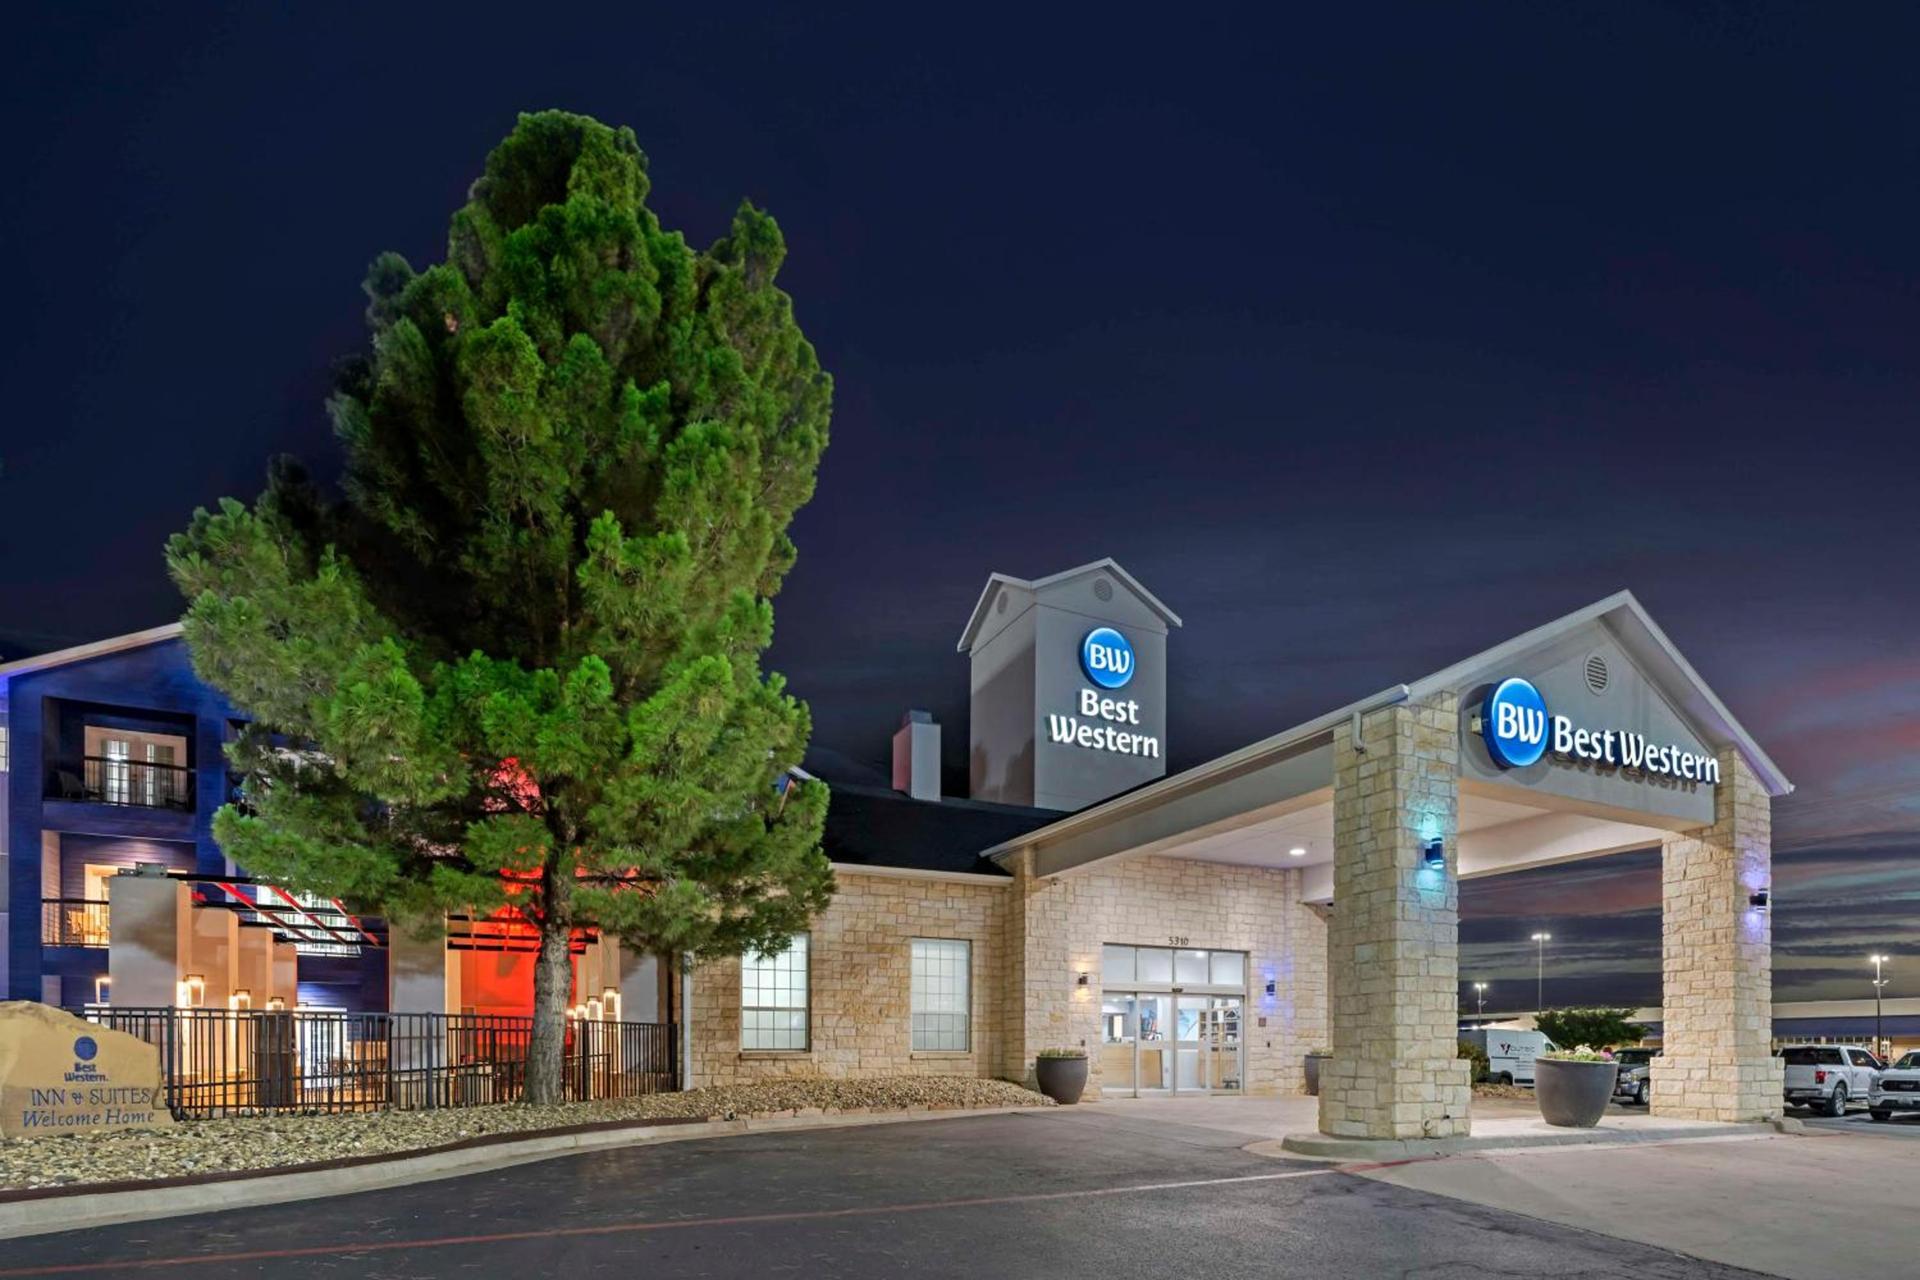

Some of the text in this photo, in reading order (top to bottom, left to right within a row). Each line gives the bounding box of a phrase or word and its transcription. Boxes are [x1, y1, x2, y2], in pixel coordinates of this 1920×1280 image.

[1090, 643, 1130, 674] BW
[1081, 689, 1139, 725] Best
[1050, 714, 1159, 758] Western
[1498, 702, 1544, 744] BW
[1554, 716, 1720, 783] Best Western
[1168, 935, 1189, 945] 5310
[74, 1063, 96, 1072] Best
[32, 1088, 150, 1106] INN & SUITES
[23, 1109, 154, 1127] Welcome Home
